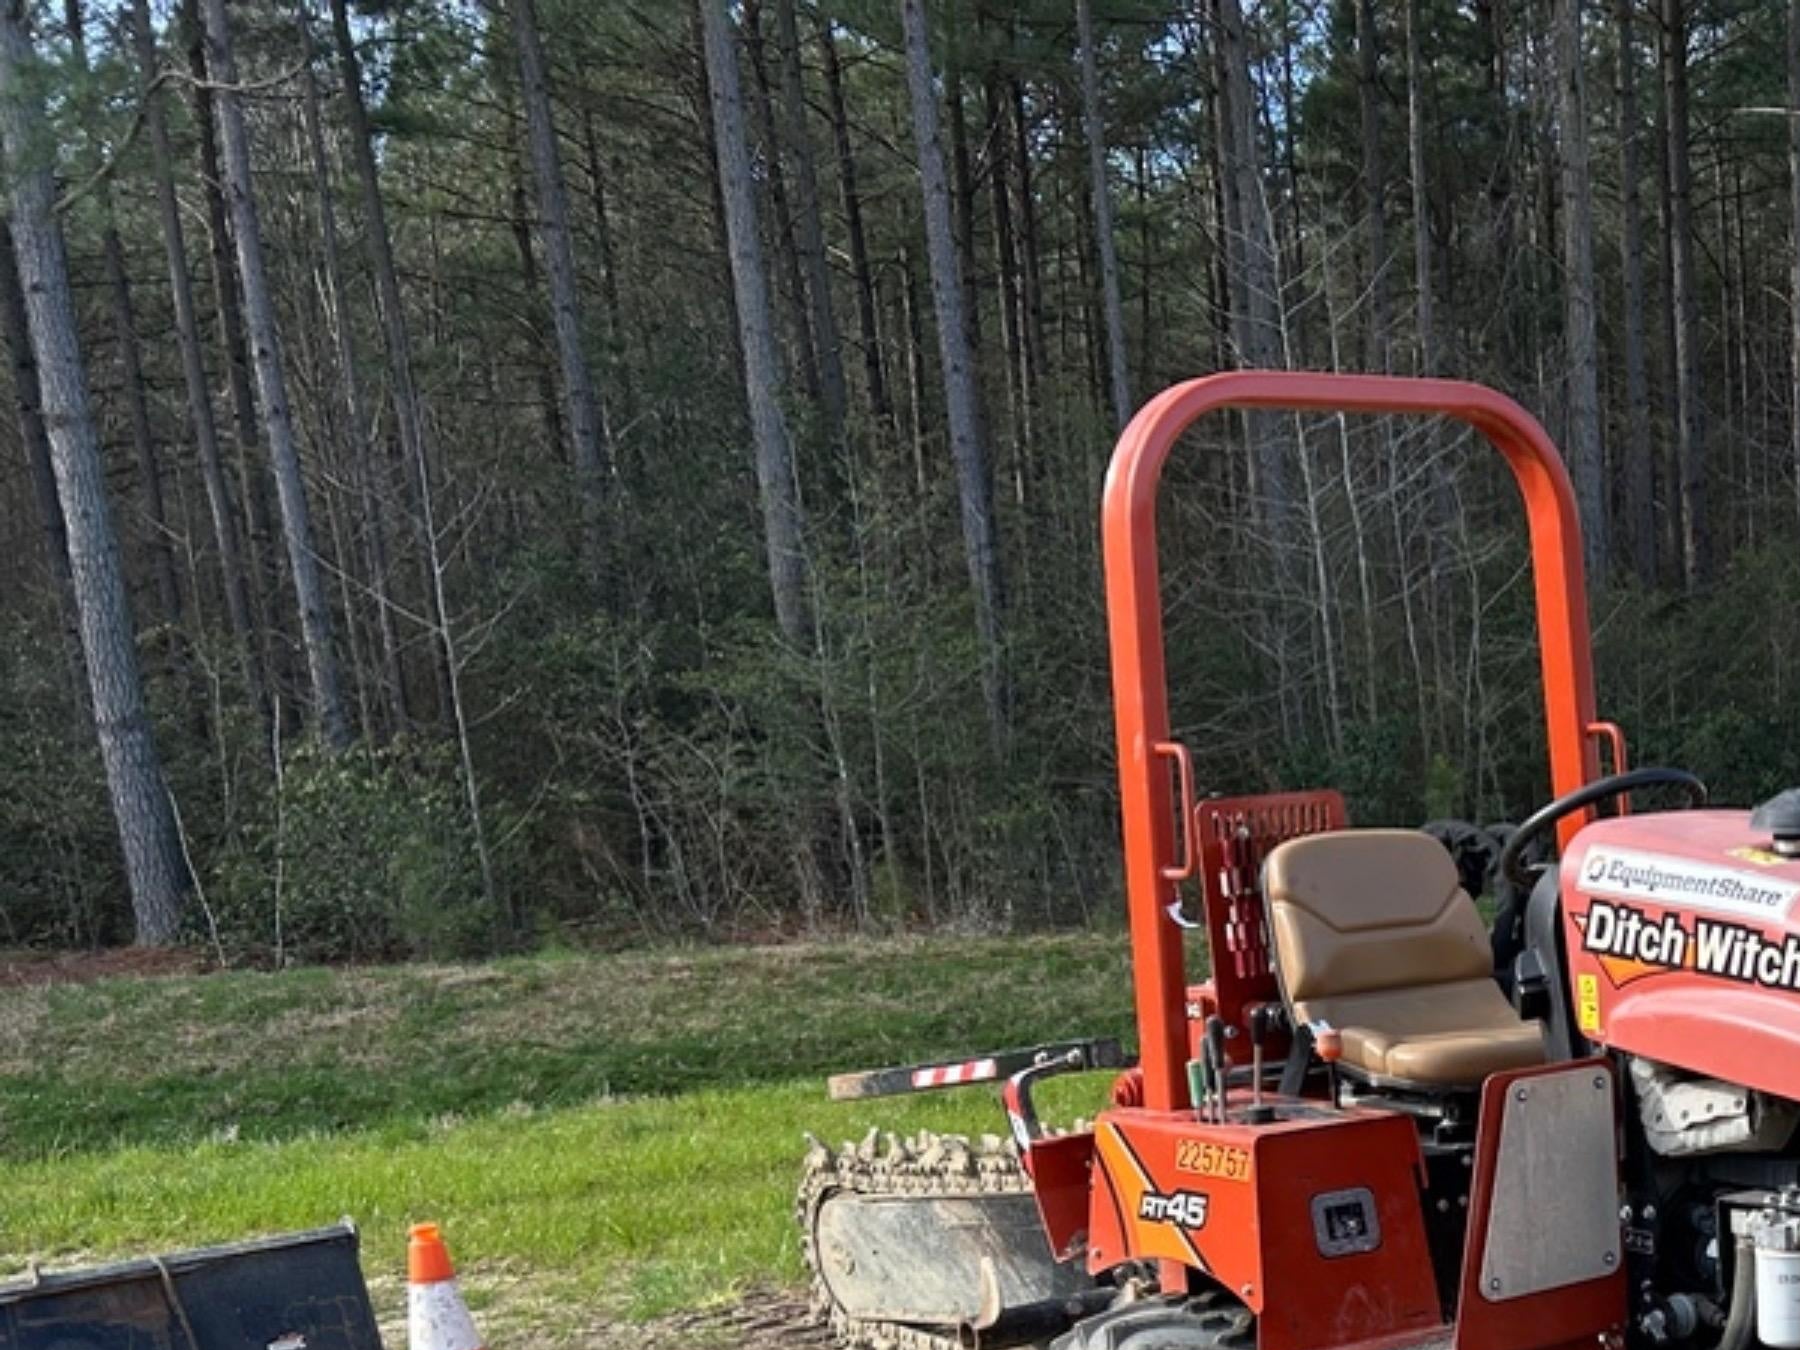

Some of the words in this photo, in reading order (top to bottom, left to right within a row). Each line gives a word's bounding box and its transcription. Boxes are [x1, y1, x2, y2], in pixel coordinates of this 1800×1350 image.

[1607, 860, 1782, 906] EquipmentShare
[1585, 901, 1684, 969] Ditch
[1178, 1141, 1250, 1178] 225757
[1141, 1192, 1208, 1227] RT45
